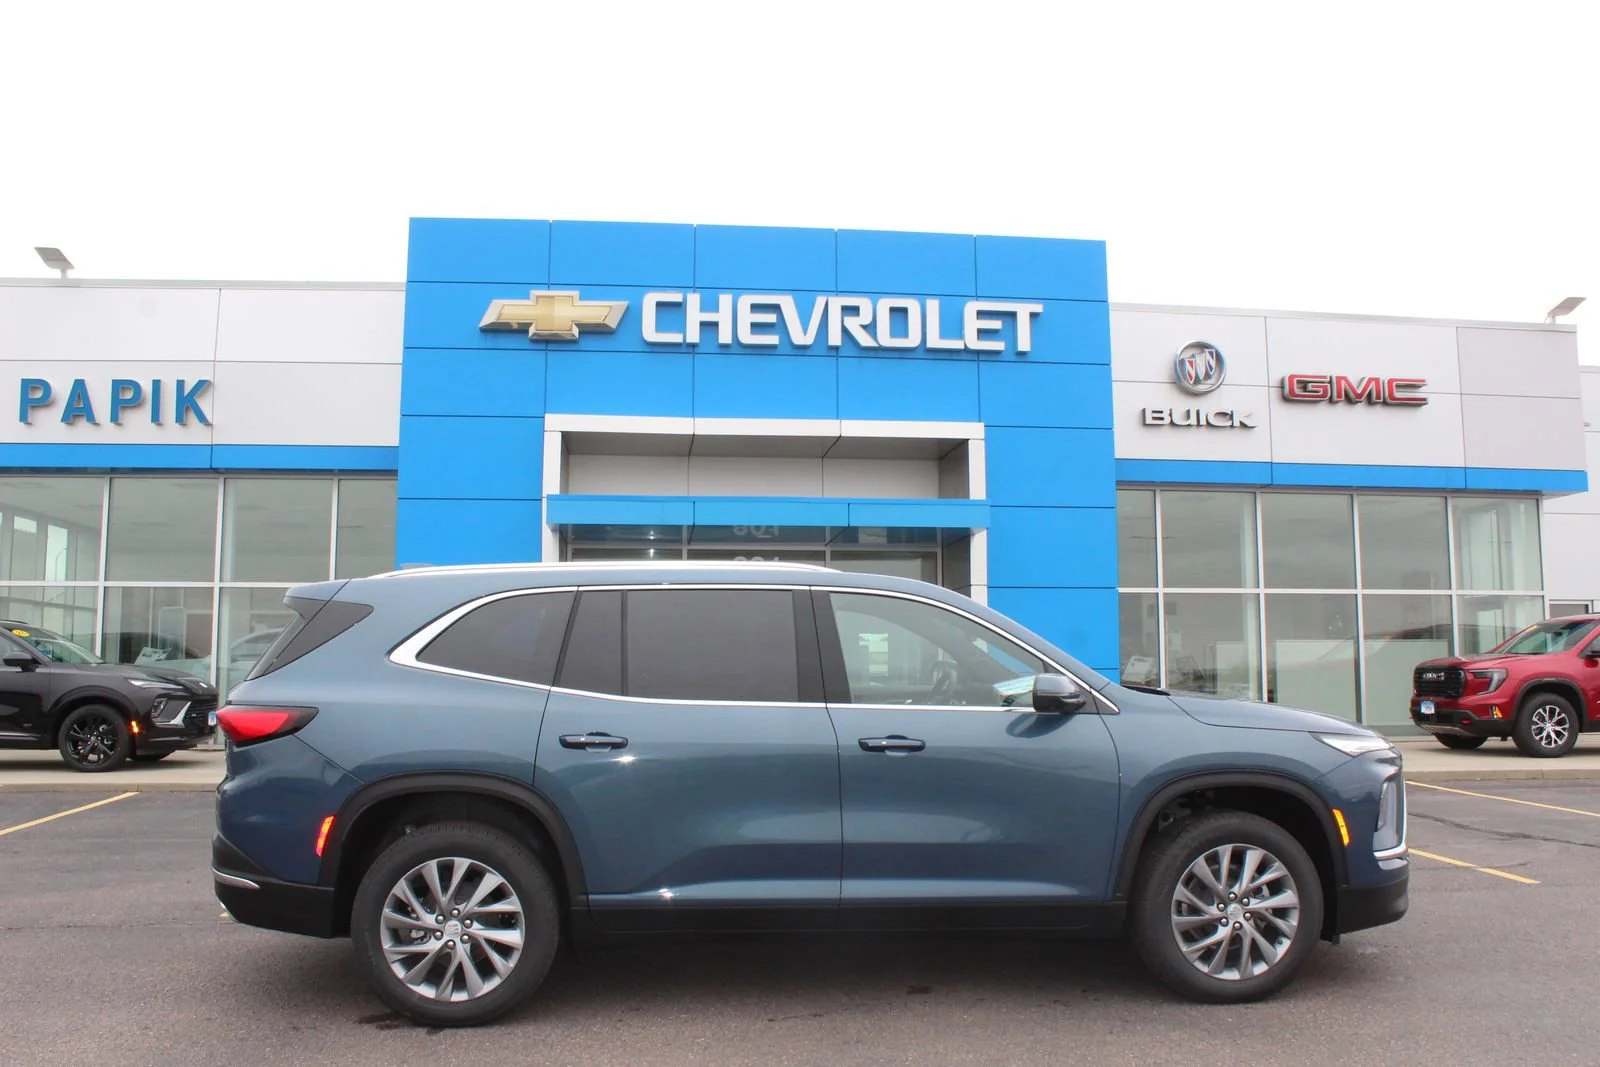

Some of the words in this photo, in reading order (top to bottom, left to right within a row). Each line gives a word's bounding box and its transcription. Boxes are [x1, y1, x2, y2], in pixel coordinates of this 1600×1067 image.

[642, 292, 1043, 352] CHEVROLET
[19, 378, 213, 426] PAPIK
[1281, 373, 1428, 406] GMC
[1142, 407, 1256, 429] BUICK
